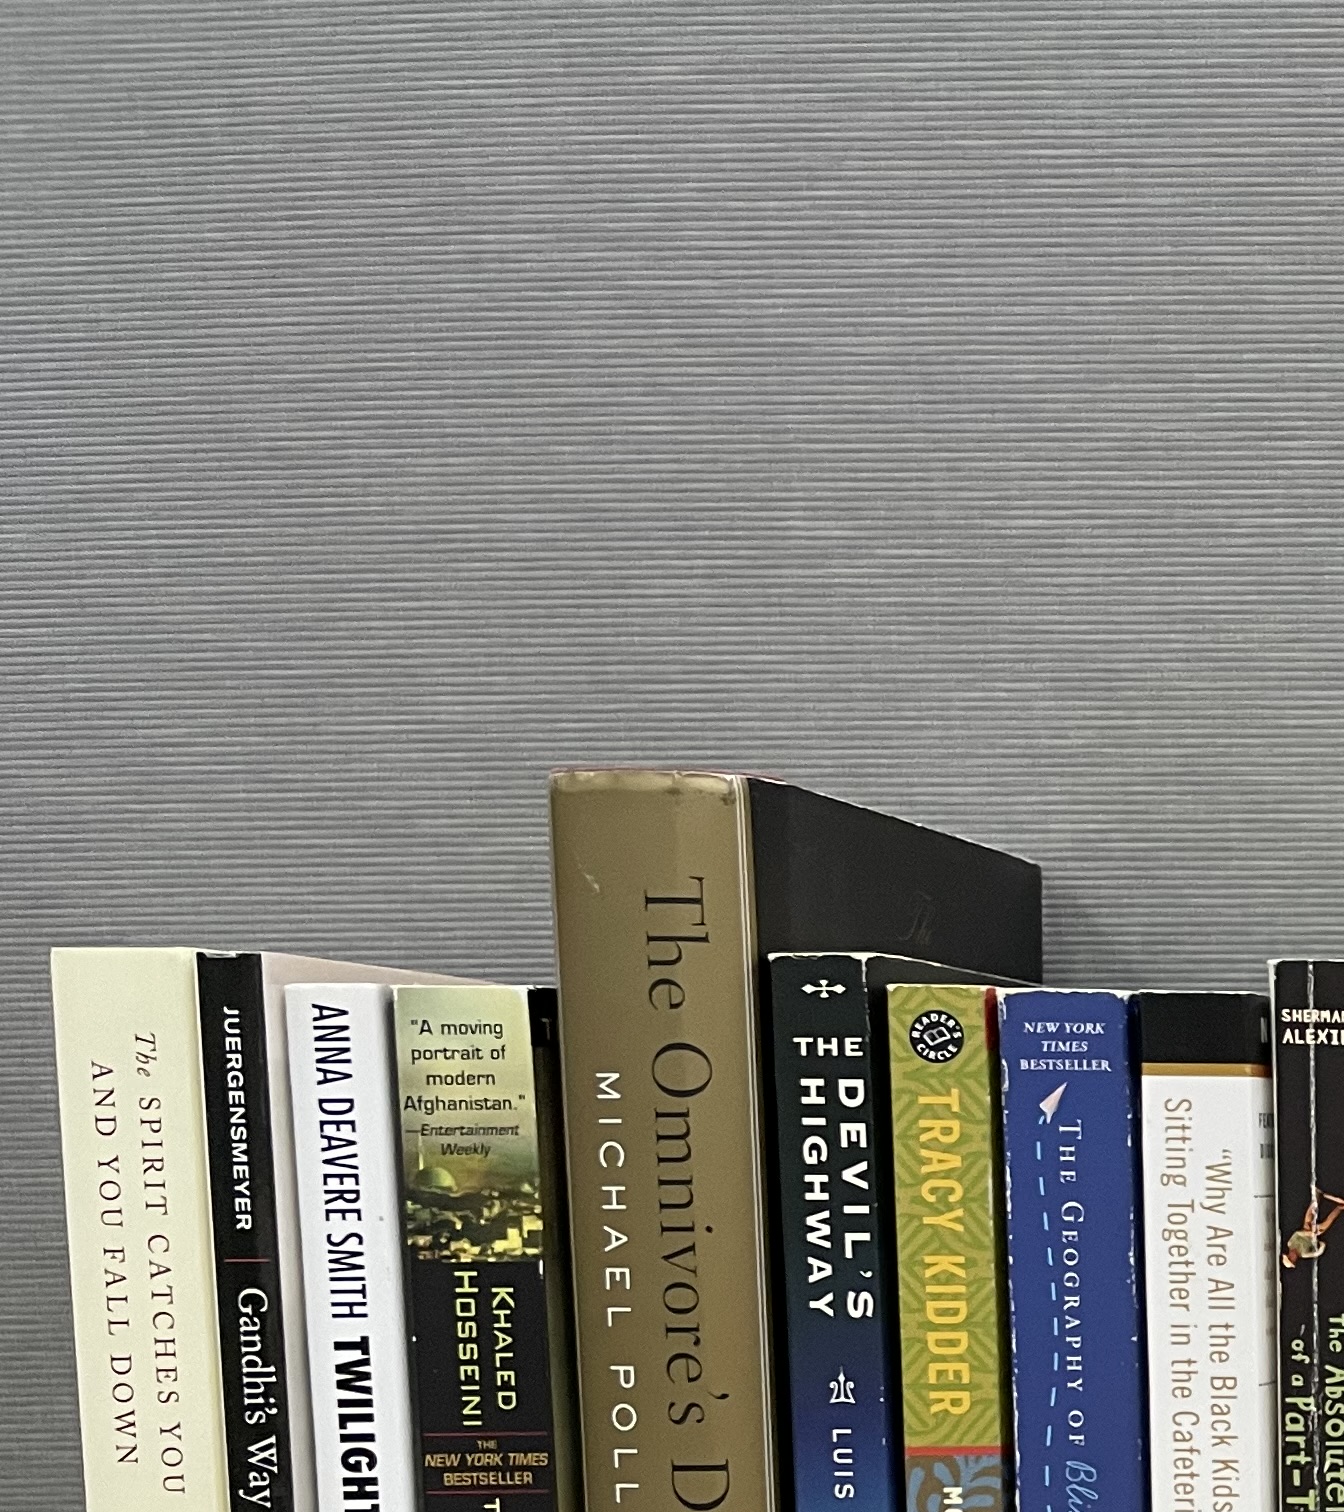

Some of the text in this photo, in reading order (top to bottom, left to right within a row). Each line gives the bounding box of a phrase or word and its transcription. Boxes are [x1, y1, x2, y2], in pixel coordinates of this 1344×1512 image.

[644, 875, 711, 1011] The
[411, 1044, 506, 1063] portrait of
[426, 1070, 496, 1086] modern
[441, 1019, 504, 1039] moving
[793, 1037, 864, 1057] THE
[1020, 1059, 1112, 1072] BESTSELLER
[1023, 1022, 1106, 1034] NEW YORK
[1041, 1041, 1088, 1052] TIMES
[224, 1006, 253, 1230] JUERGENSMEYER
[312, 1003, 368, 1319] ANNA DEAVERE SMITH
[133, 1031, 186, 1494] The SPIRIT CATCHES YOU
[651, 1042, 730, 1426] Omnivore's
[800, 1078, 834, 1317] HIGHWAY
[838, 1078, 874, 1319] DEVIL'S
[917, 1089, 972, 1416] TRACY KIDDER
[237, 1287, 277, 1509] Gandhi's Way
[454, 1271, 483, 1427] HOSSEINI
[491, 1287, 517, 1410] KHALED
[443, 1472, 533, 1487] BESTSELLER
